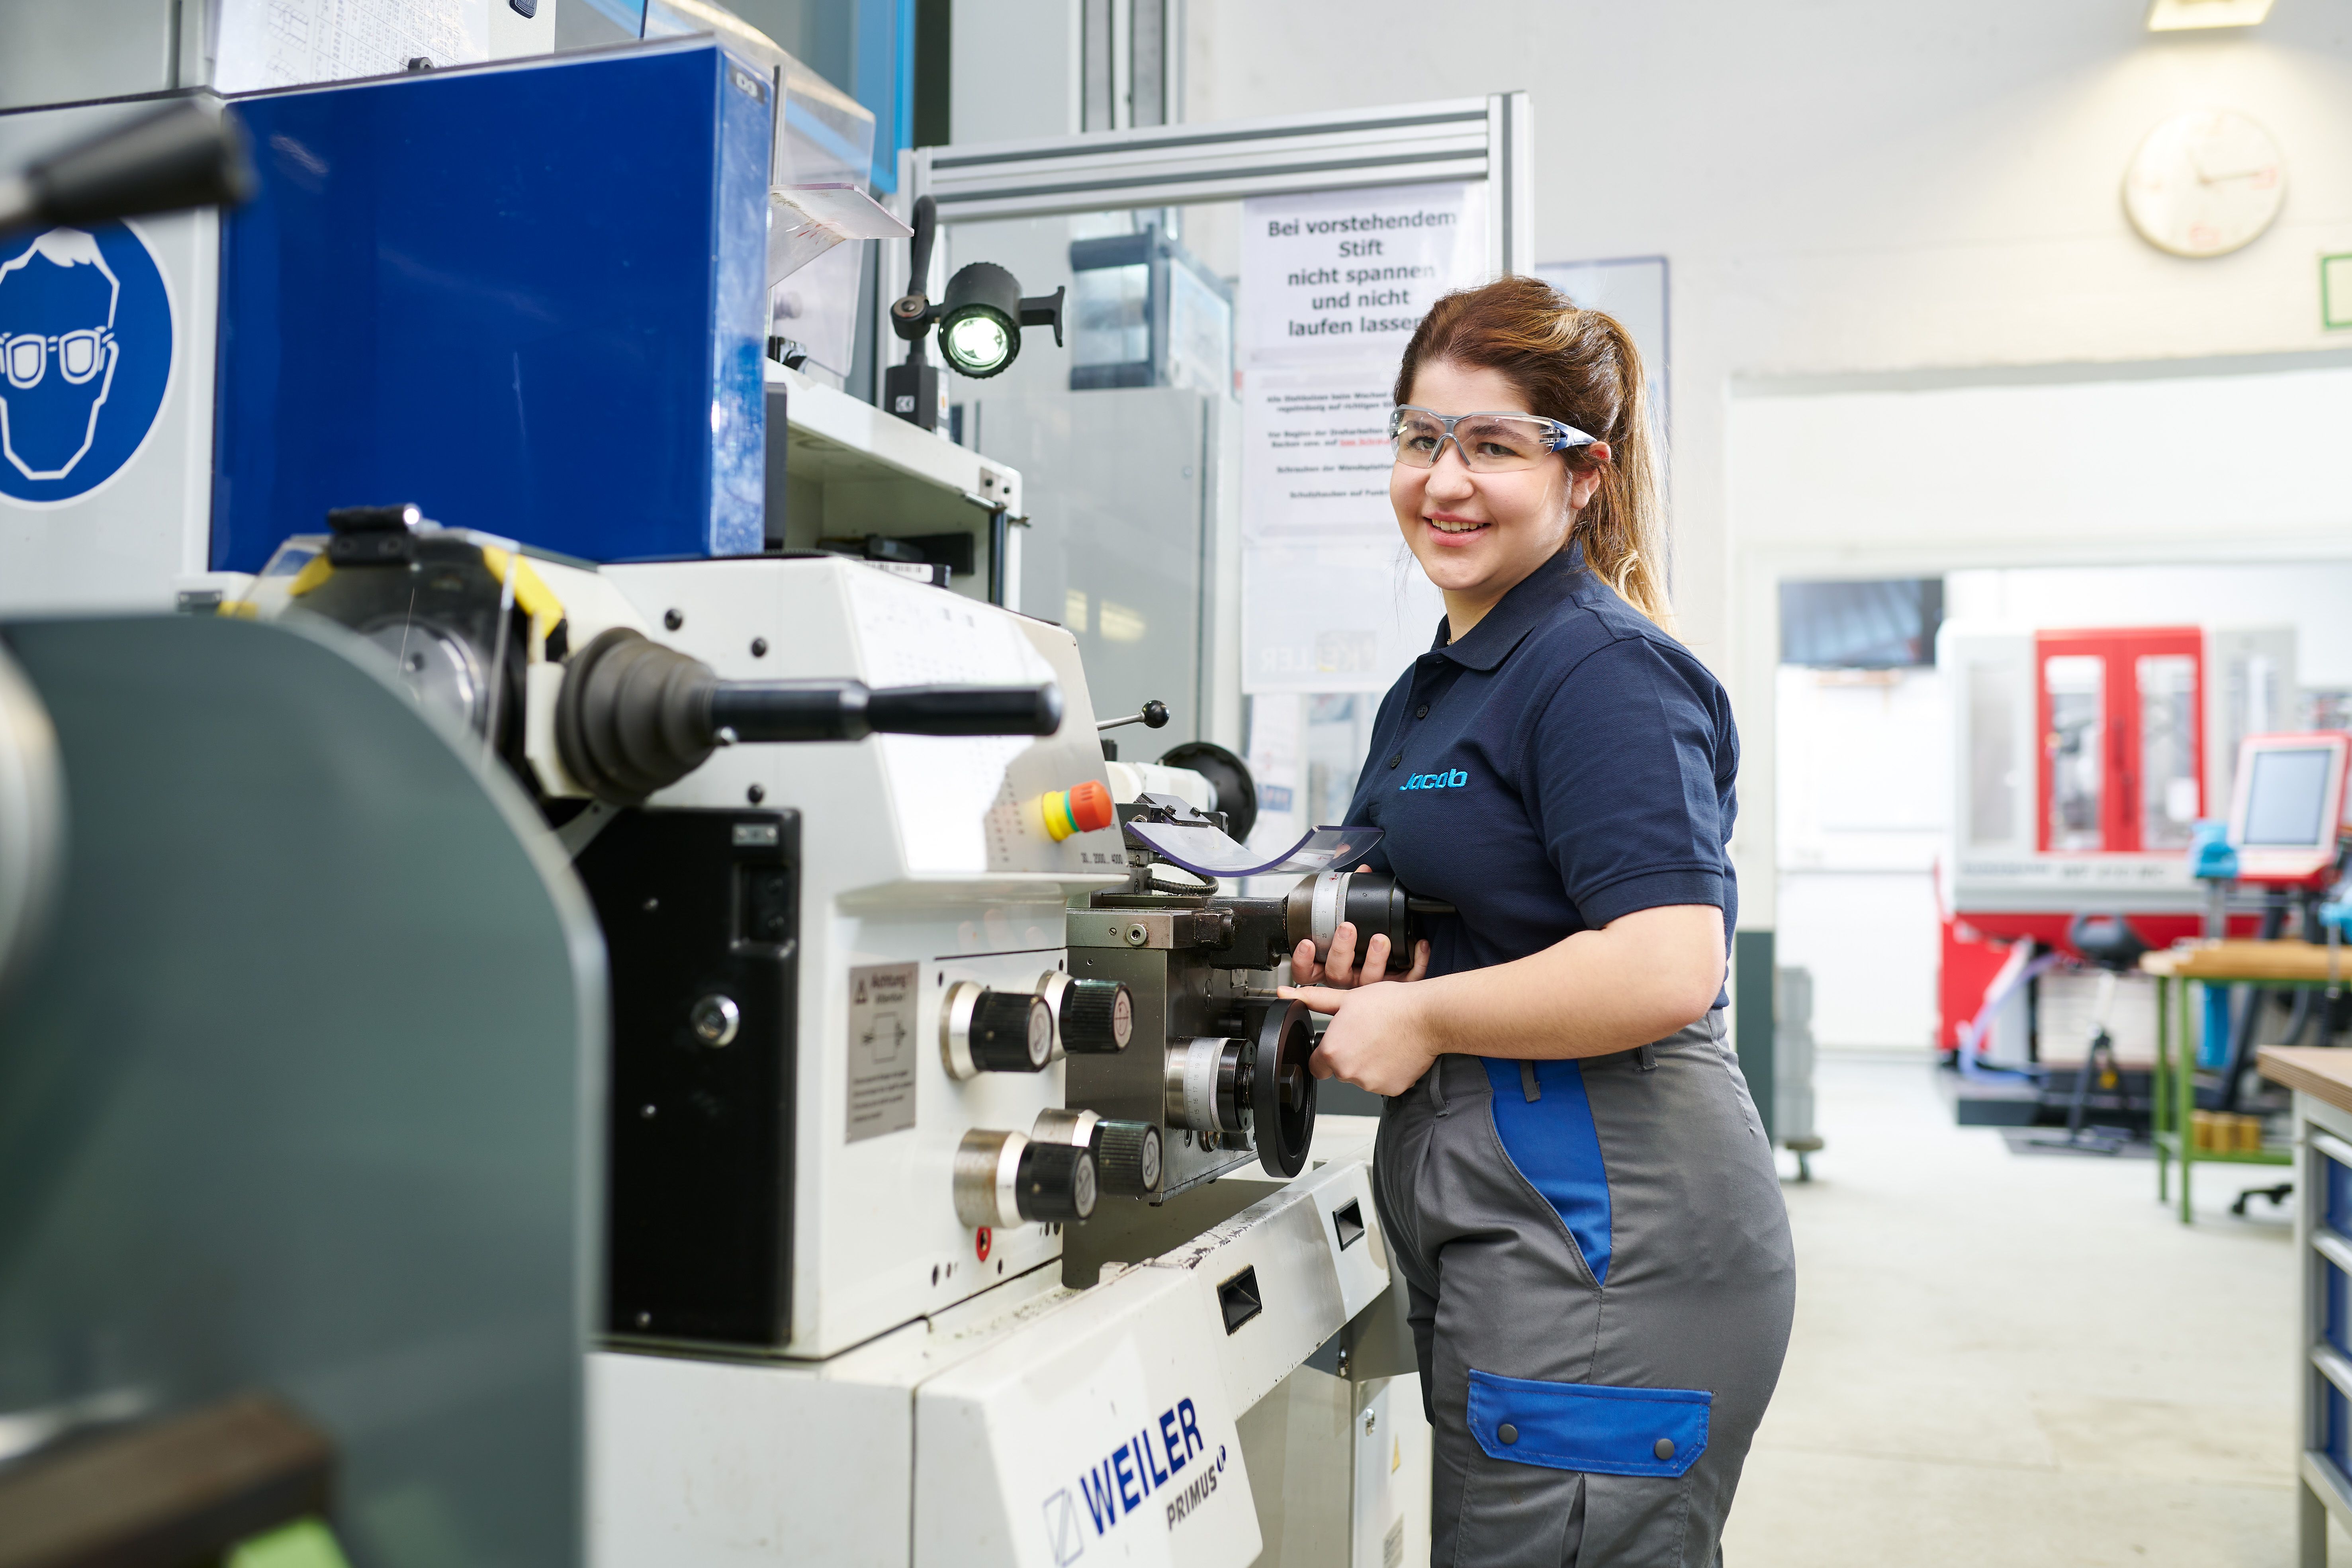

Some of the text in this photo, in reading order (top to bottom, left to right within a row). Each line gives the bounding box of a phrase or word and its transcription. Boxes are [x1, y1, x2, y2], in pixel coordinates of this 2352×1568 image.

[1268, 210, 1456, 237] Bei vorstehendem
[1338, 239, 1383, 258] Stift
[1288, 265, 1434, 286] nicht spannen
[1312, 289, 1410, 310] und nicht
[1289, 317, 1352, 337] laufen
[1399, 769, 1468, 791] Jacob
[1080, 1397, 1203, 1535] WEILER
[1166, 1464, 1217, 1532] PRIMUS
